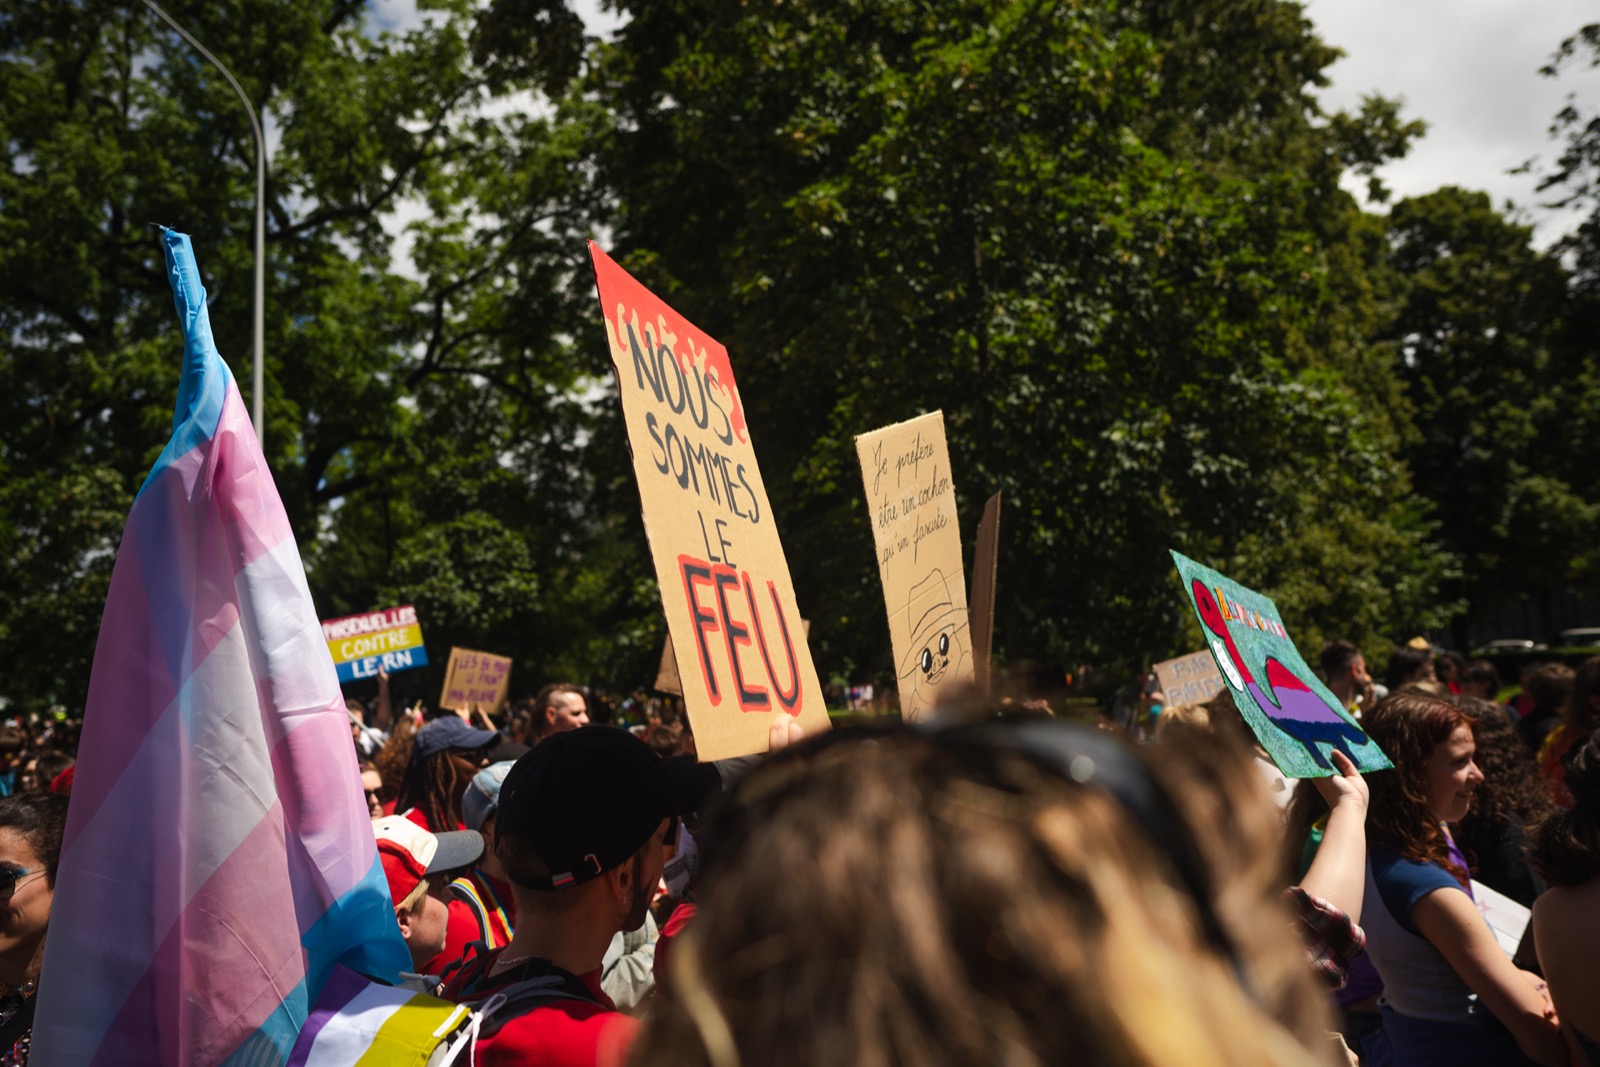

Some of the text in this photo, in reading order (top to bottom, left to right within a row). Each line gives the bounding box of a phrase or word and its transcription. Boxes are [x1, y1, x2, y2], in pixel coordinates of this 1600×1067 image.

[627, 323, 733, 446] NOUS
[646, 411, 760, 524] SOMMES
[872, 439, 888, 497] Je
[878, 463, 950, 529] être un cochon
[697, 510, 737, 569] LE
[881, 531, 909, 581] qu'un
[341, 627, 410, 661] CONTRE
[351, 649, 413, 679] LE RN
[677, 553, 803, 718] FEU
